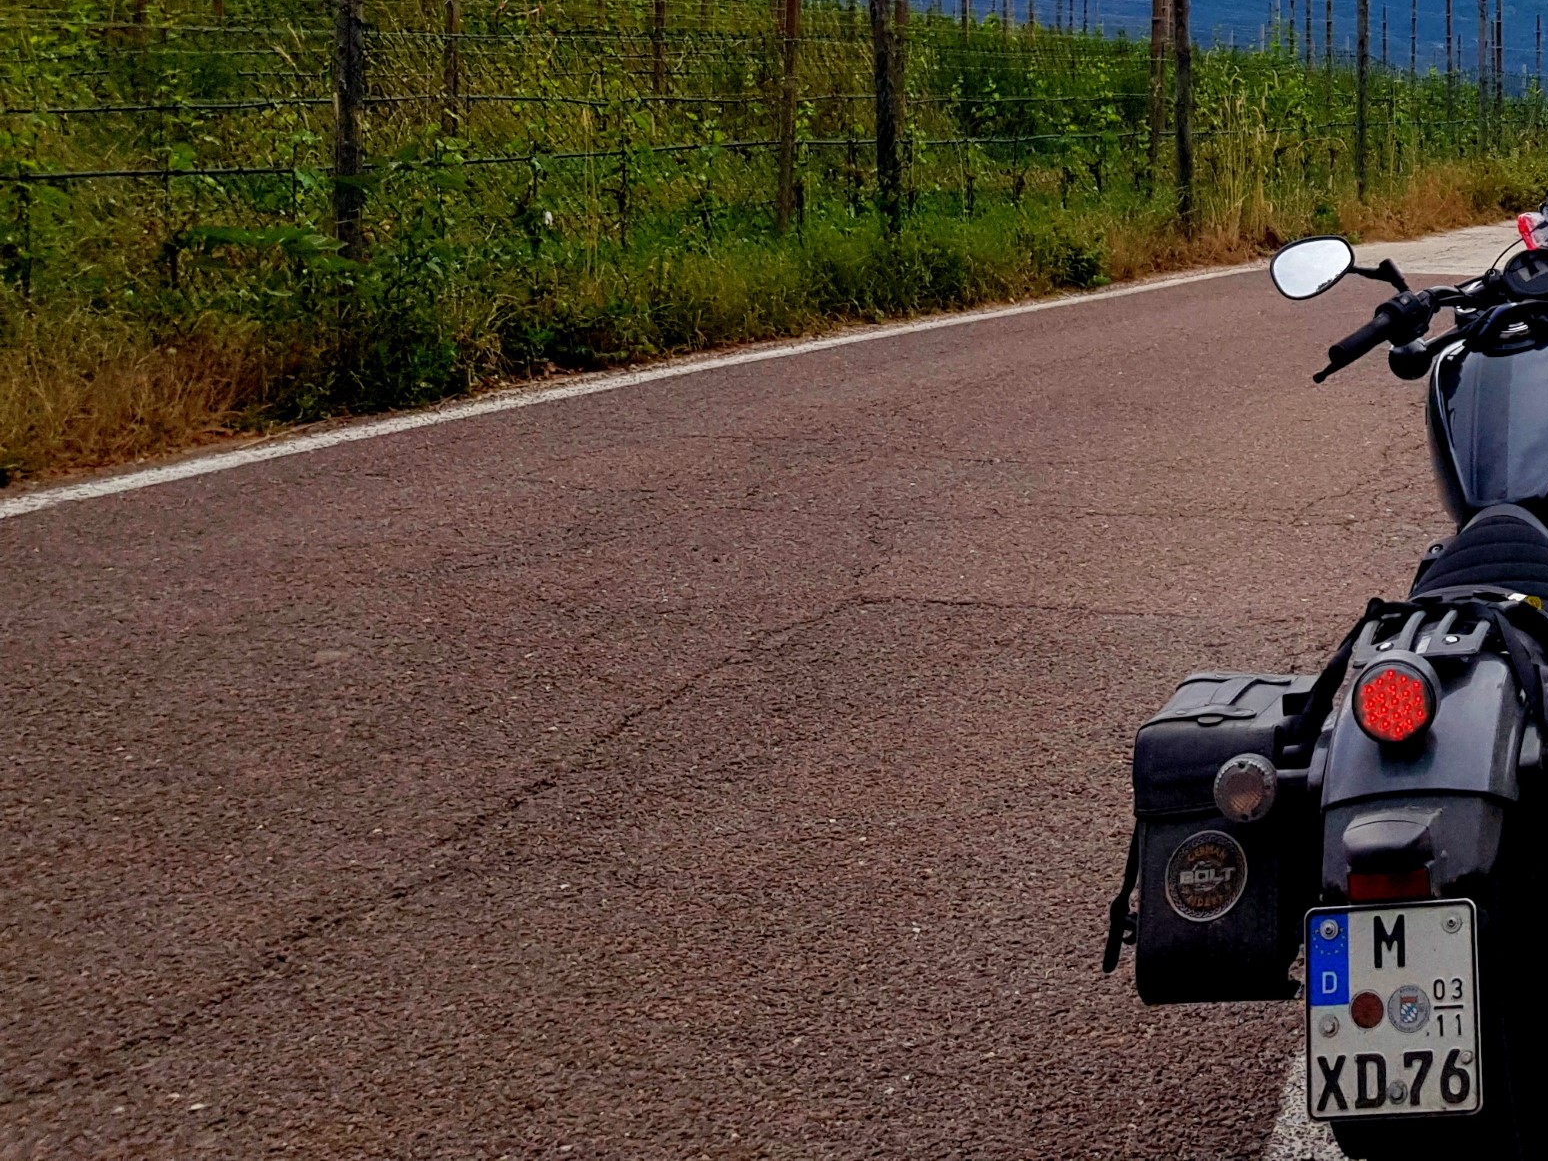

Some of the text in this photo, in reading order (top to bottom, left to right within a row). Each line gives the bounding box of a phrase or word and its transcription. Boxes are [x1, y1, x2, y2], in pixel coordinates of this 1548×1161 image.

[1180, 867, 1236, 885] BOLT
[1373, 914, 1406, 969] M
[1321, 971, 1338, 994] D
[1433, 977, 1464, 1000] 03
[1436, 1013, 1463, 1037] 11
